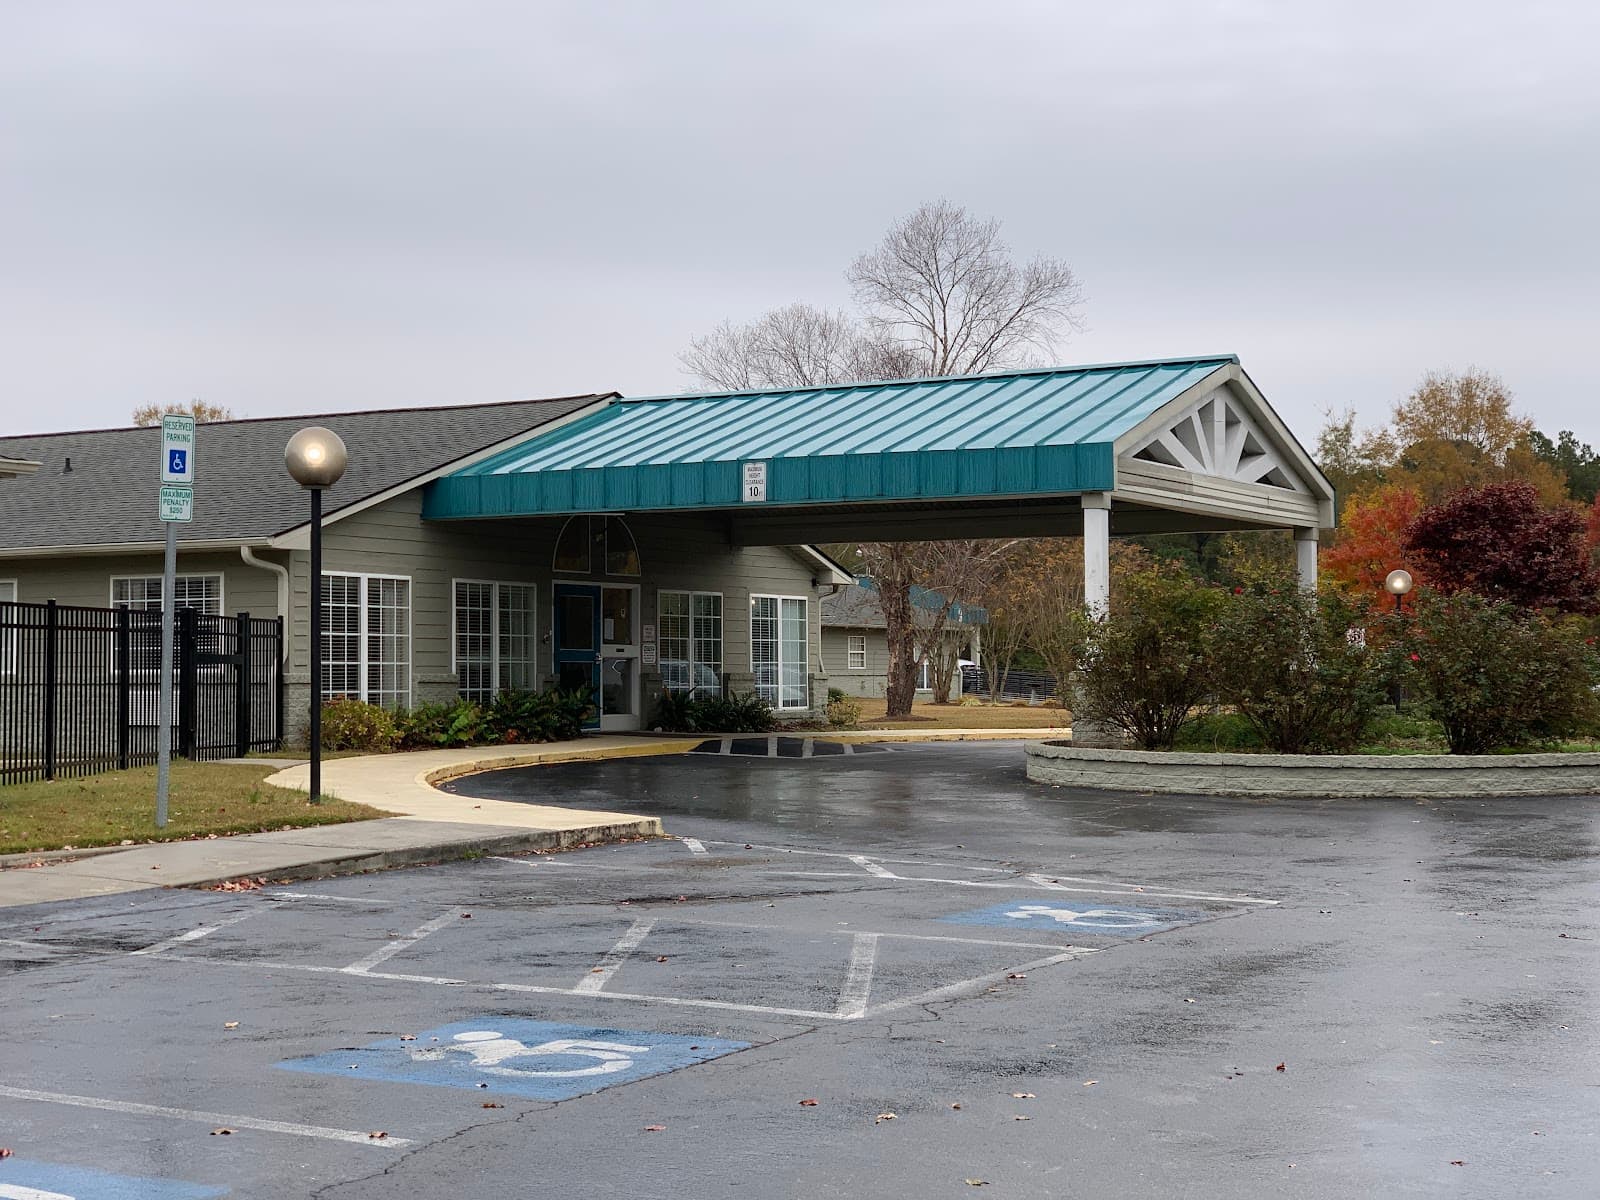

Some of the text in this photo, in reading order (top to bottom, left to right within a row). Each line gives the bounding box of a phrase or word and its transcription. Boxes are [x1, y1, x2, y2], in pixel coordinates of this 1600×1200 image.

[165, 421, 192, 431] RESERVED
[166, 432, 191, 442] PARKING
[163, 490, 190, 498] MAXIMUM
[749, 486, 759, 497] 10
